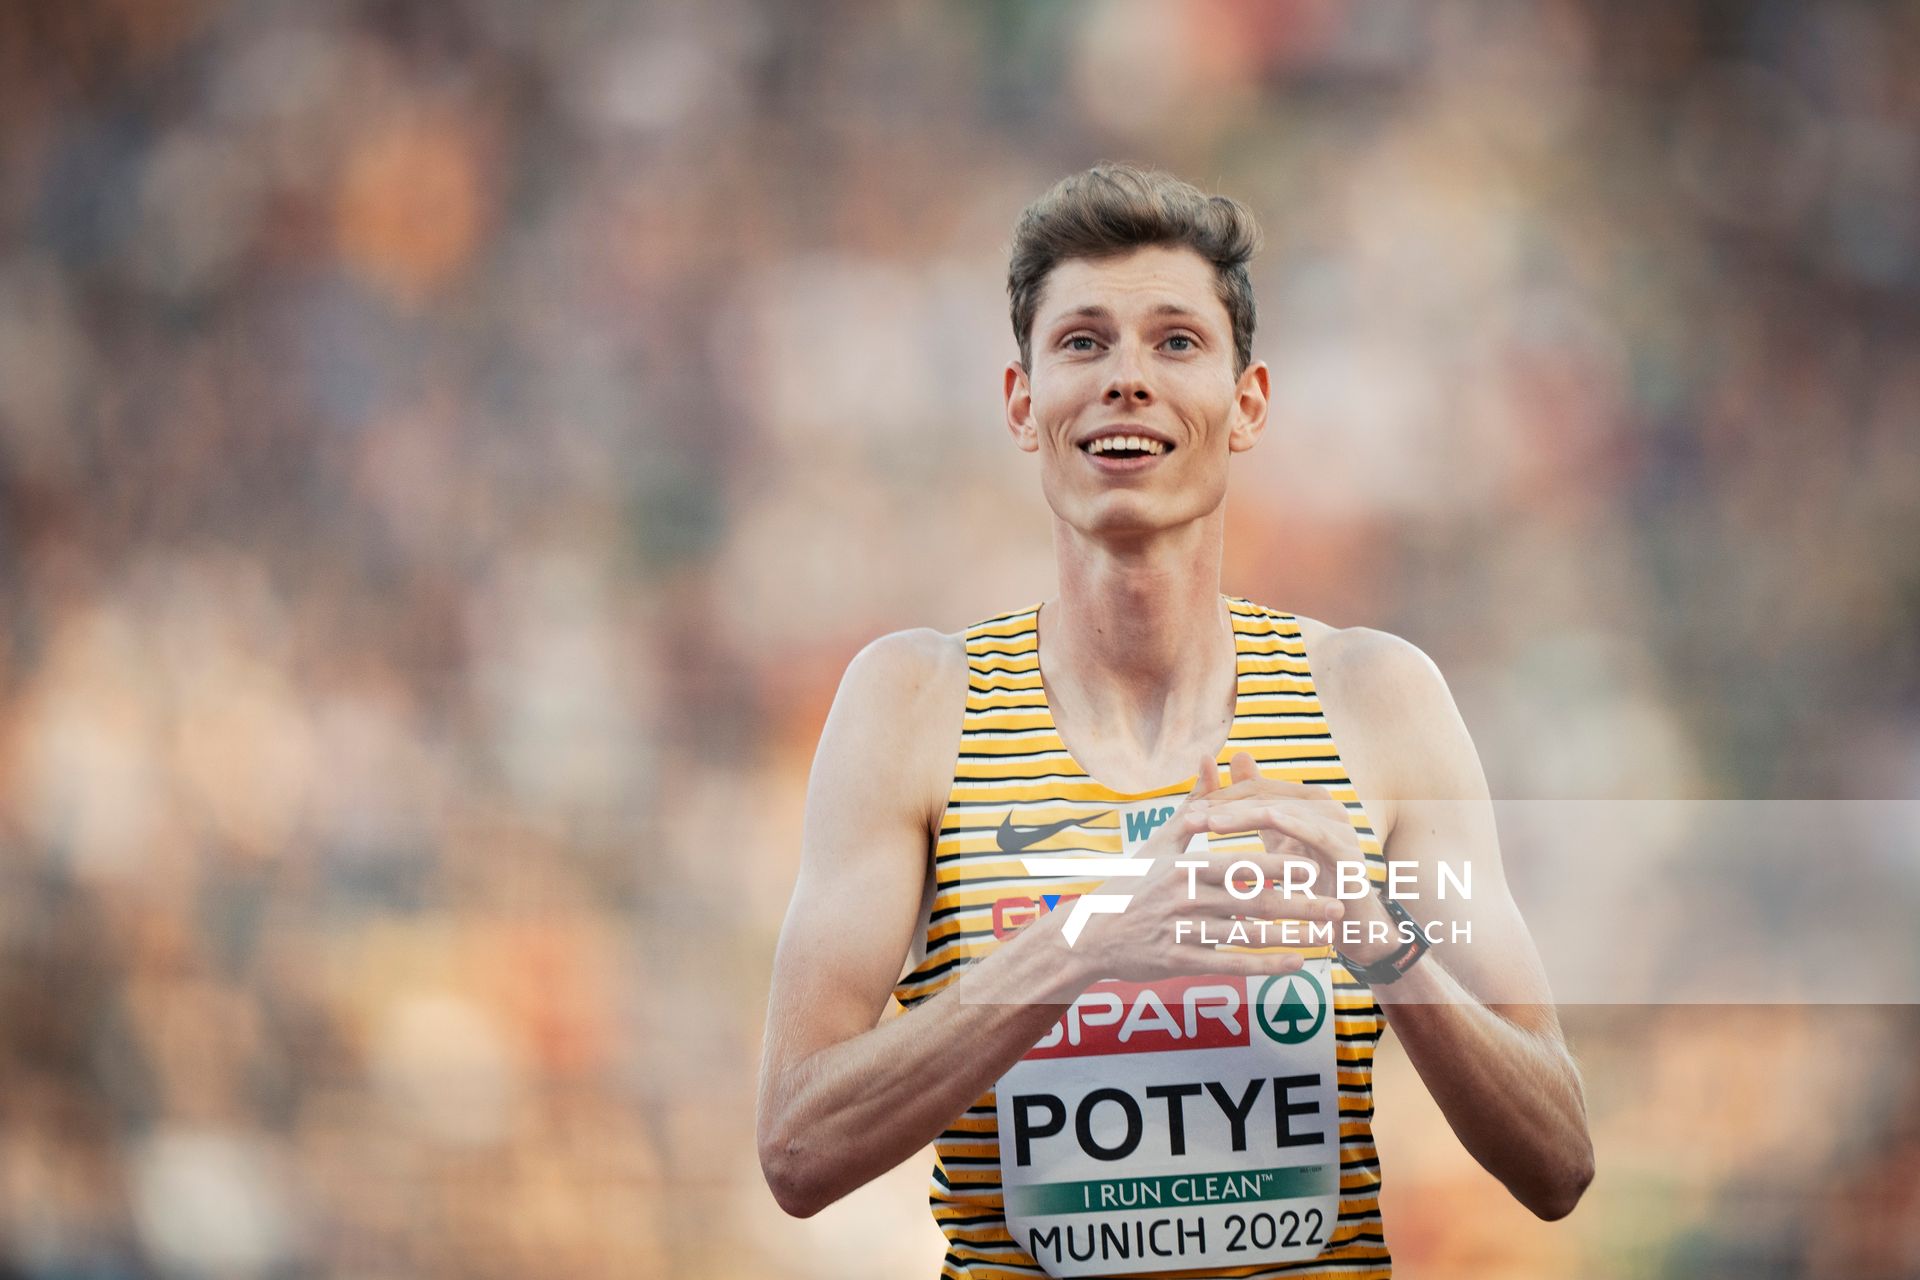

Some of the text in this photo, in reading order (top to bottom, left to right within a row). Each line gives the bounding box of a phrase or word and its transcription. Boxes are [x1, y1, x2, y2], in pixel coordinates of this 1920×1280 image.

[1012, 1073, 1325, 1167] POTYE
[1084, 1185, 1090, 1208] I
[1101, 1181, 1161, 1207] RUN
[1029, 1208, 1323, 1263] MUNICH 2022
